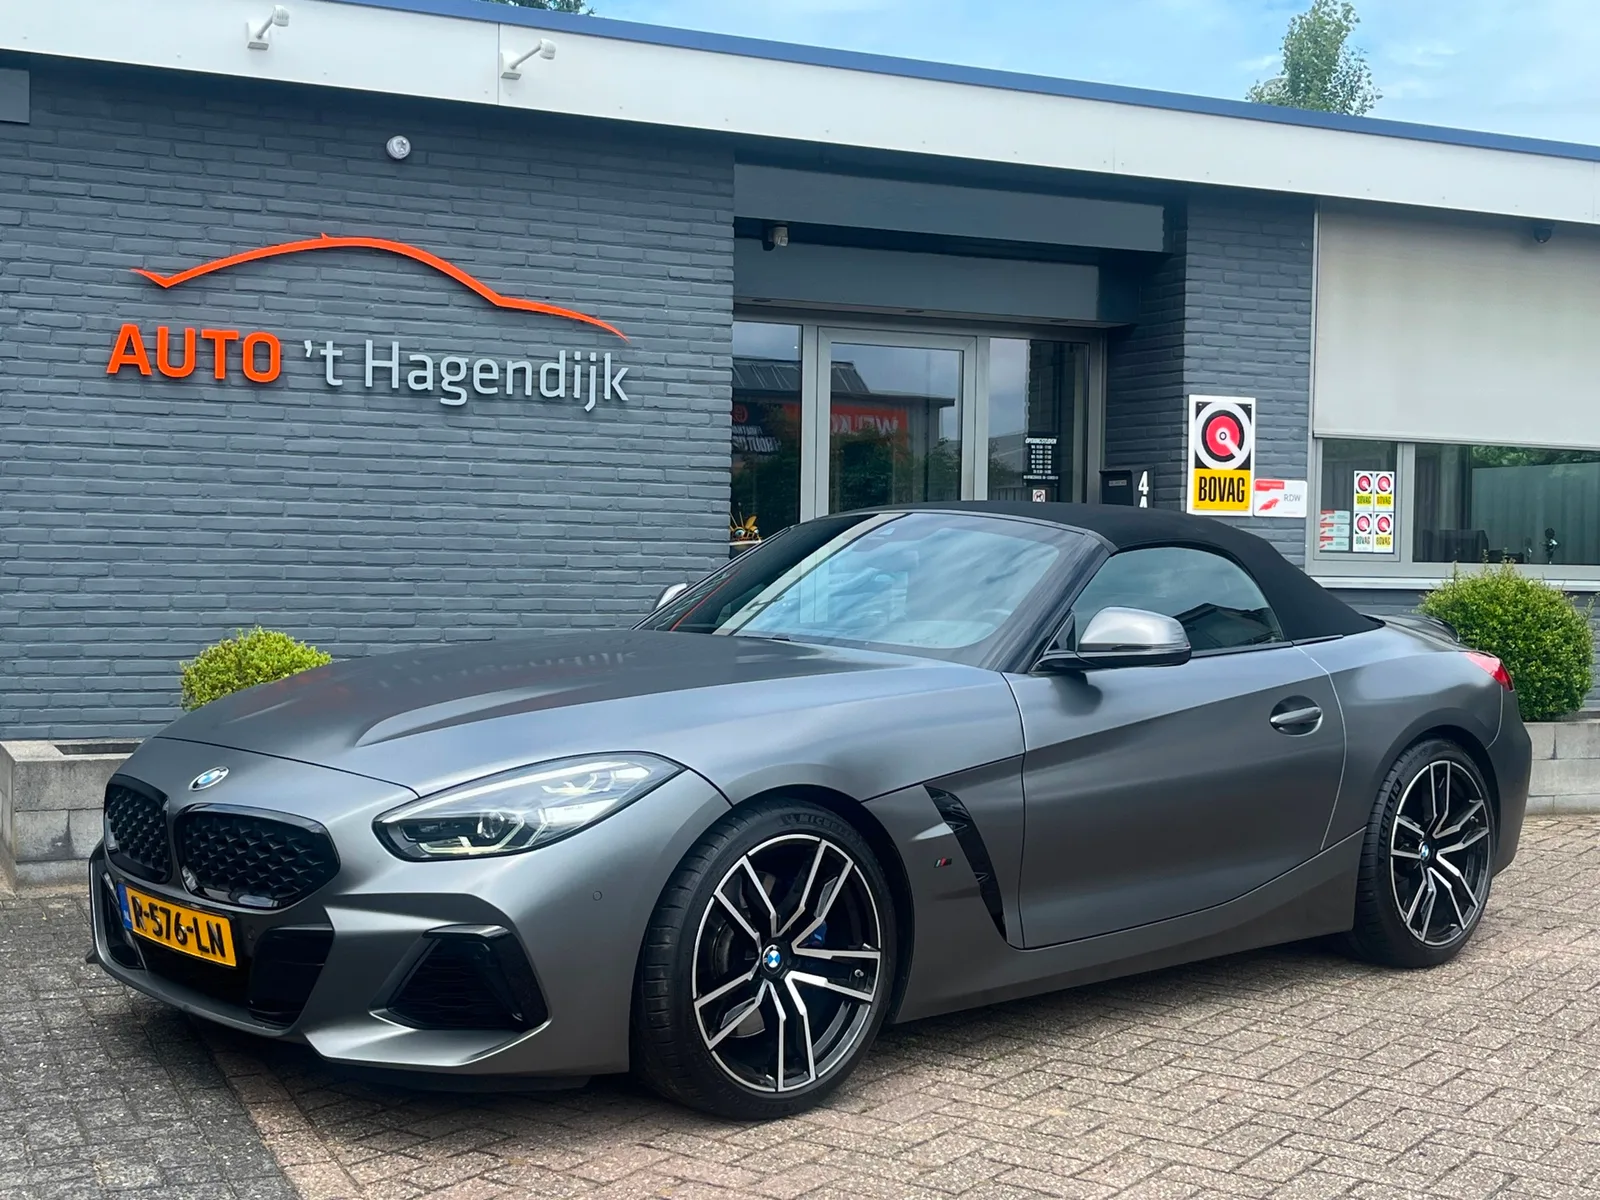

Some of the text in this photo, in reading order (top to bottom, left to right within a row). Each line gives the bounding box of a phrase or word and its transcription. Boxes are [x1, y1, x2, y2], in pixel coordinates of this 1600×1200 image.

[106, 323, 281, 383] AUTO
[365, 340, 629, 412] Hagendijk
[1138, 470, 1149, 495] 4
[1199, 476, 1246, 503] BOVAG
[1284, 494, 1301, 502] RDW
[131, 895, 226, 958] R-576-LN
